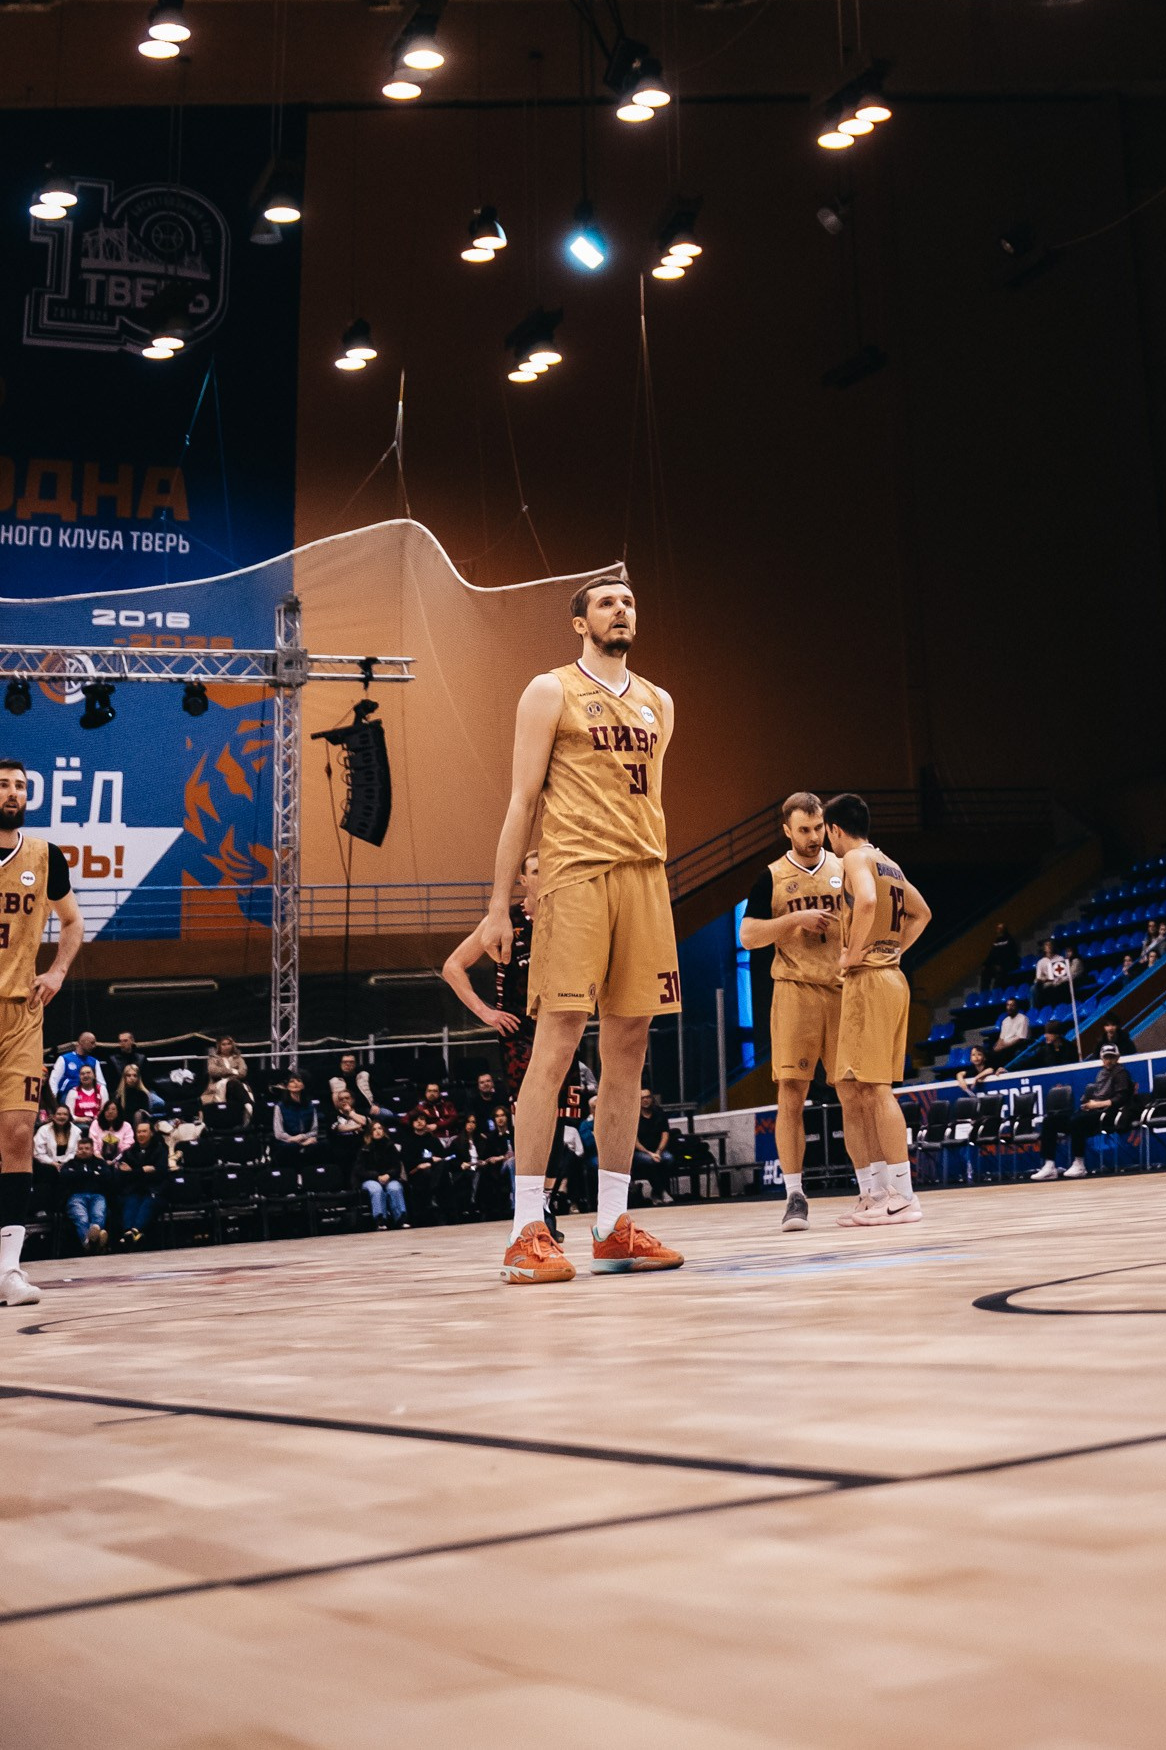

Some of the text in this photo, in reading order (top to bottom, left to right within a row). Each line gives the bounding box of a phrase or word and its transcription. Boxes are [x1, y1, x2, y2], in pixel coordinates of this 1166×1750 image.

[79, 271, 211, 314] ТВЕ
[59, 527, 124, 551] КЛУБА
[130, 530, 191, 555] ТВЕРЬ
[91, 608, 191, 629] 2016
[622, 763, 648, 797] 31
[0, 892, 36, 915] ВС
[657, 970, 681, 1005] 31
[23, 1075, 40, 1104] 13
